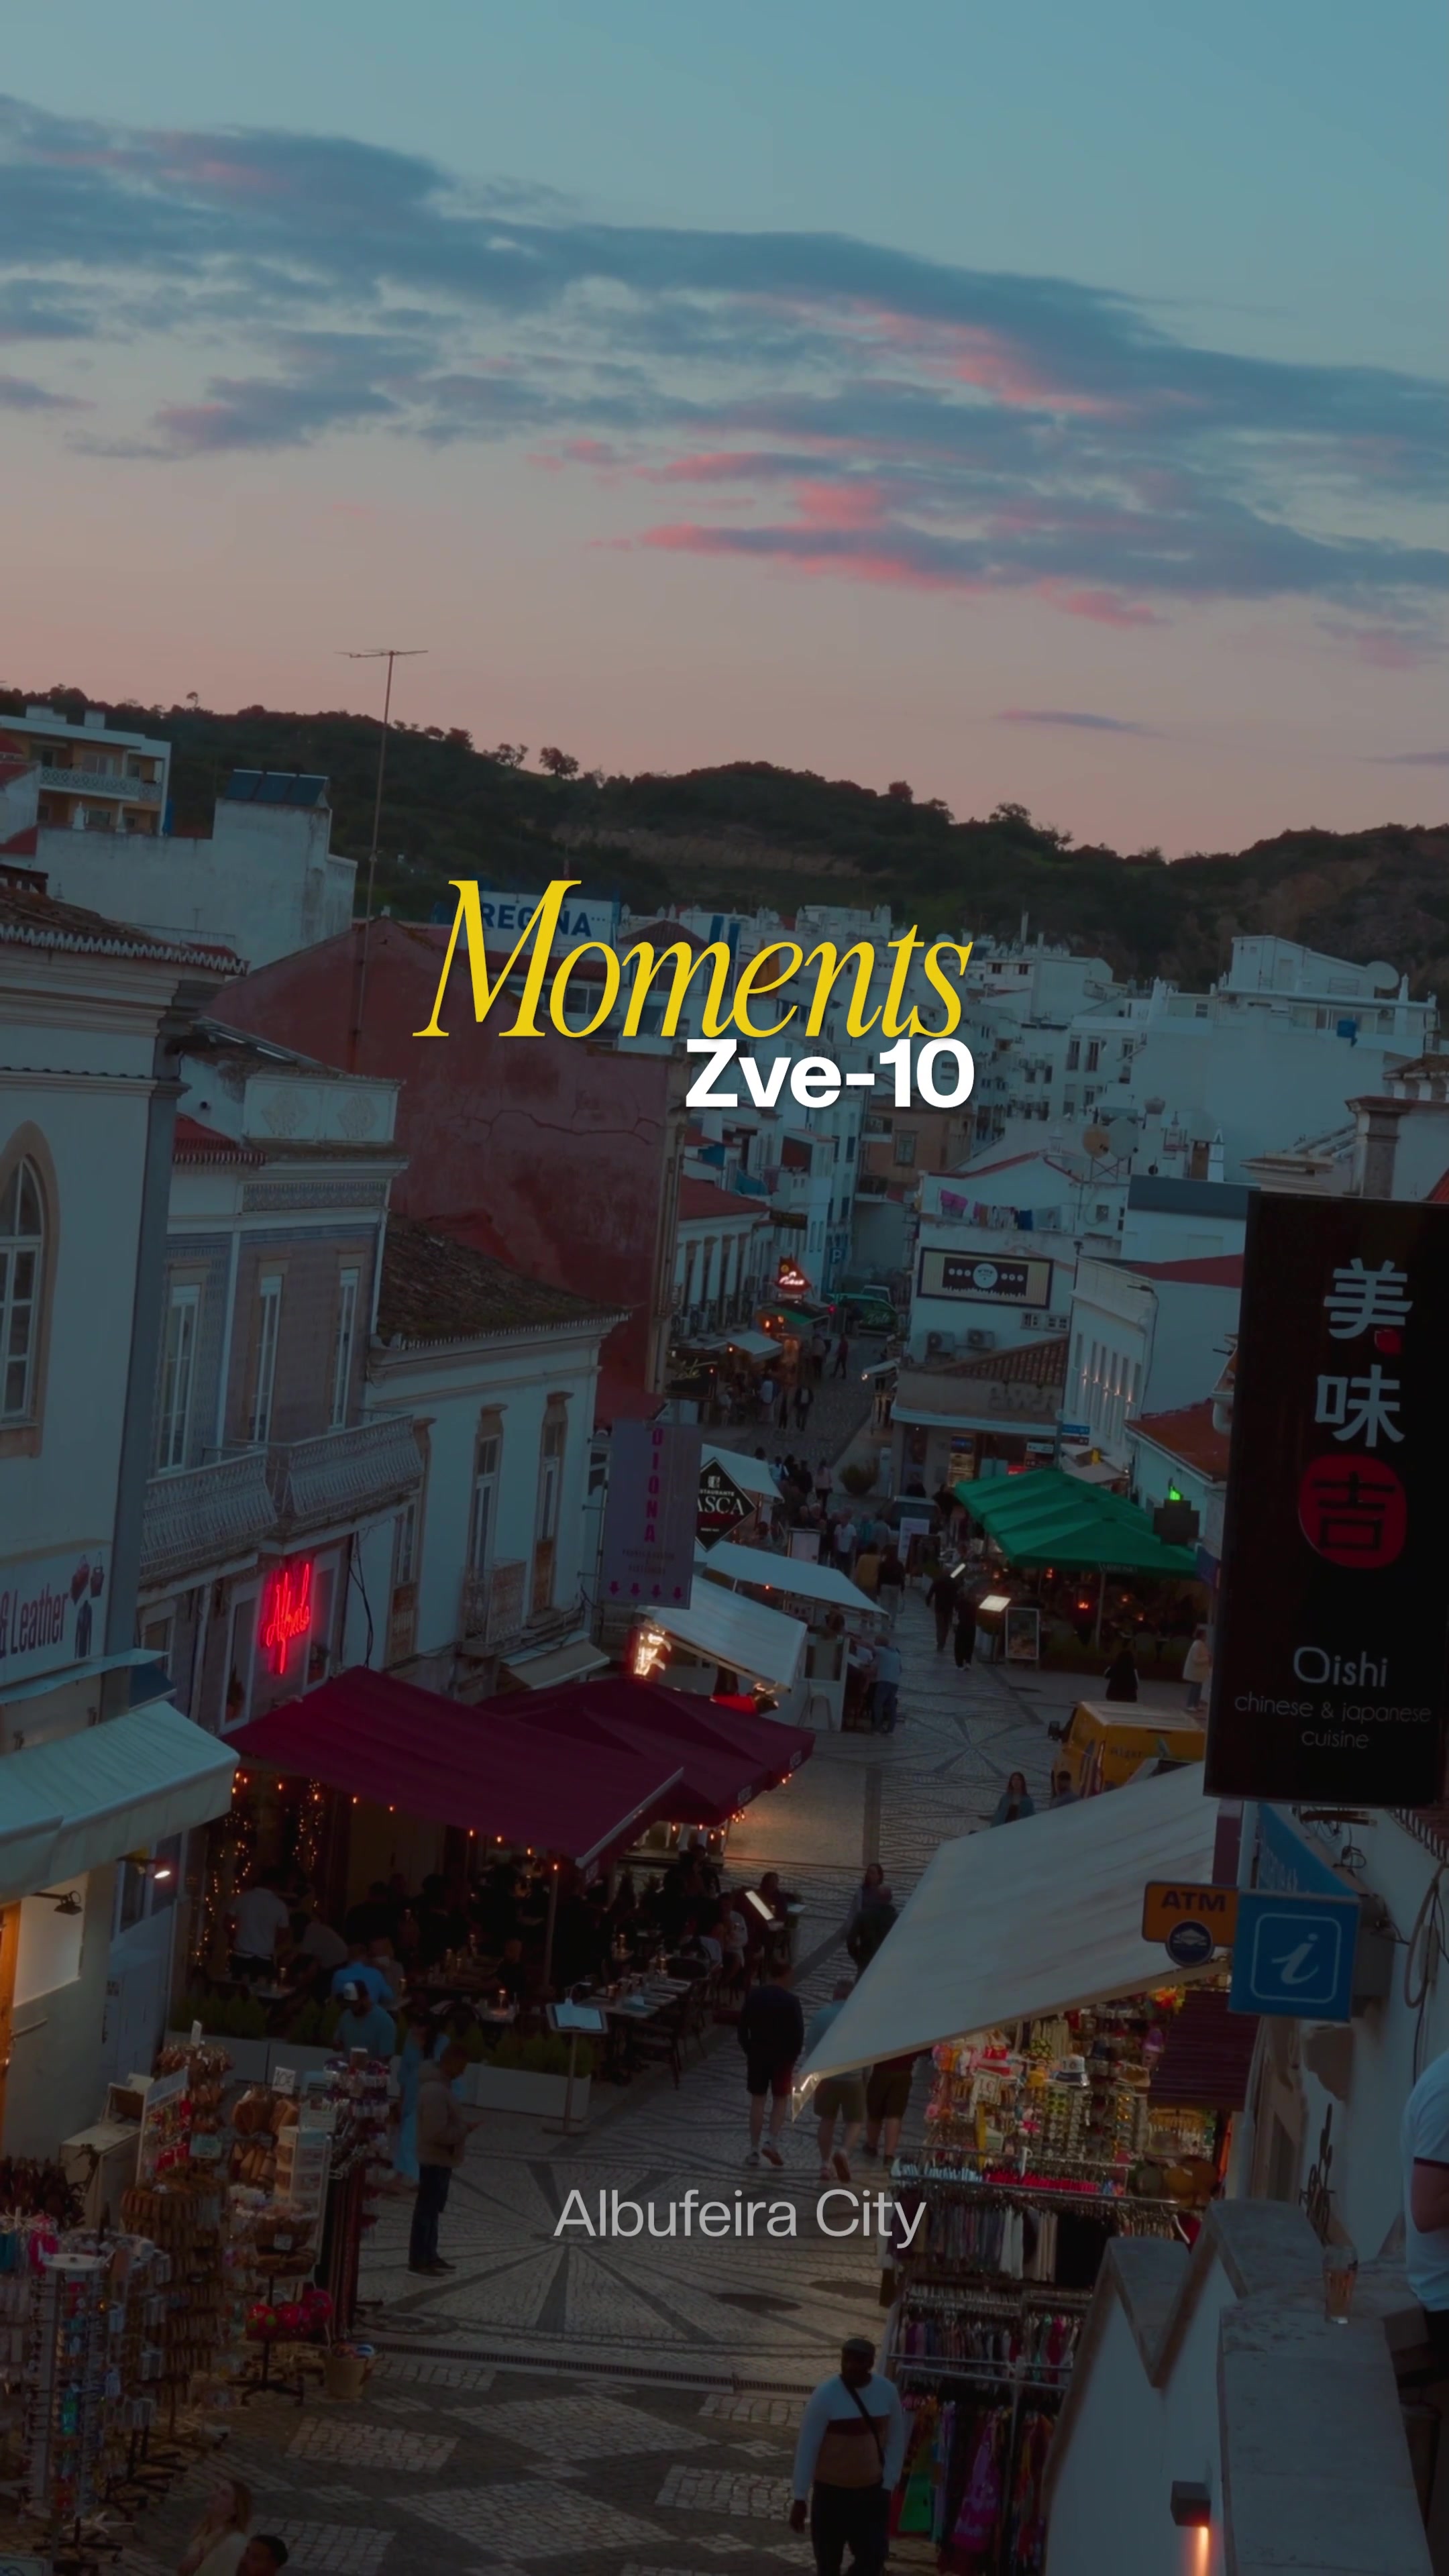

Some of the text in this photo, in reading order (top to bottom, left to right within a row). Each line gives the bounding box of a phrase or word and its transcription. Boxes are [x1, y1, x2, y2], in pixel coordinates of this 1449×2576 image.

[481, 903, 592, 937] REGNA
[697, 1495, 745, 1515] ASCA
[11, 1582, 68, 1655] Leather
[1293, 1646, 1388, 1688] Oishi
[1234, 1690, 1432, 1725] chinese & japanese
[1301, 1729, 1369, 1749] cuisine
[1161, 1890, 1226, 1912] ATM
